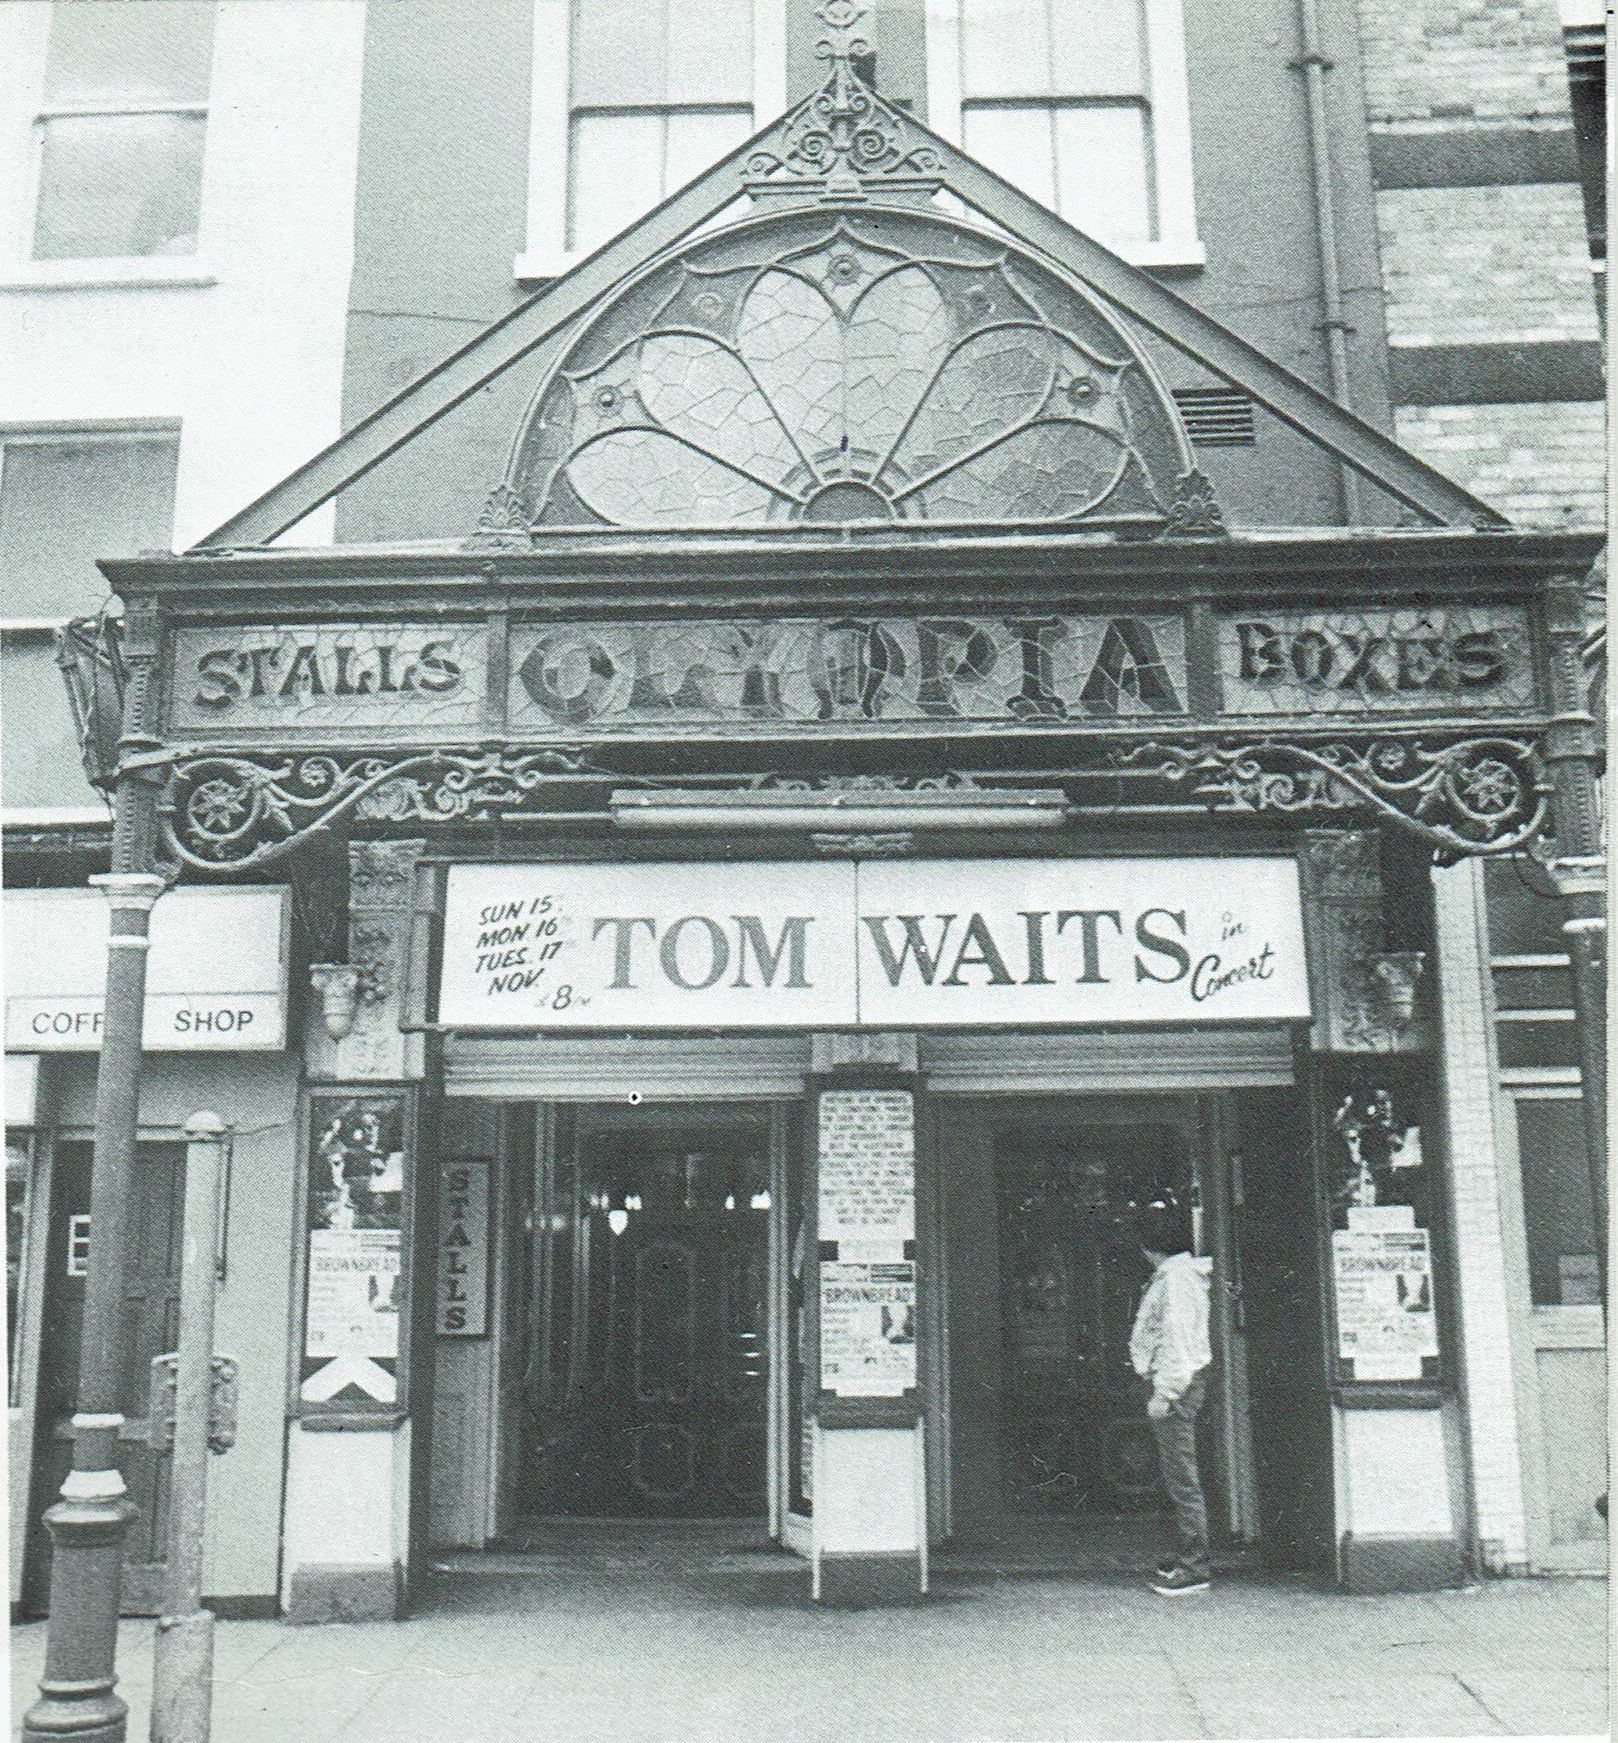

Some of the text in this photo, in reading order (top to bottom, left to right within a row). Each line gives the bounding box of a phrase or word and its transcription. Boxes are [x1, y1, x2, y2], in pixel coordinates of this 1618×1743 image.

[197, 640, 462, 708] STALLS
[517, 617, 1190, 725] OLYMPIA
[1235, 622, 1503, 694] BOXES
[476, 922, 531, 949] MON
[478, 901, 525, 927] SUN
[1220, 910, 1246, 941] in
[591, 907, 1191, 990] TOM WAITS
[1190, 942, 1277, 1002] Concert
[32, 1009, 254, 1035] COFF SHOP
[444, 1168, 471, 1331] STALLS
